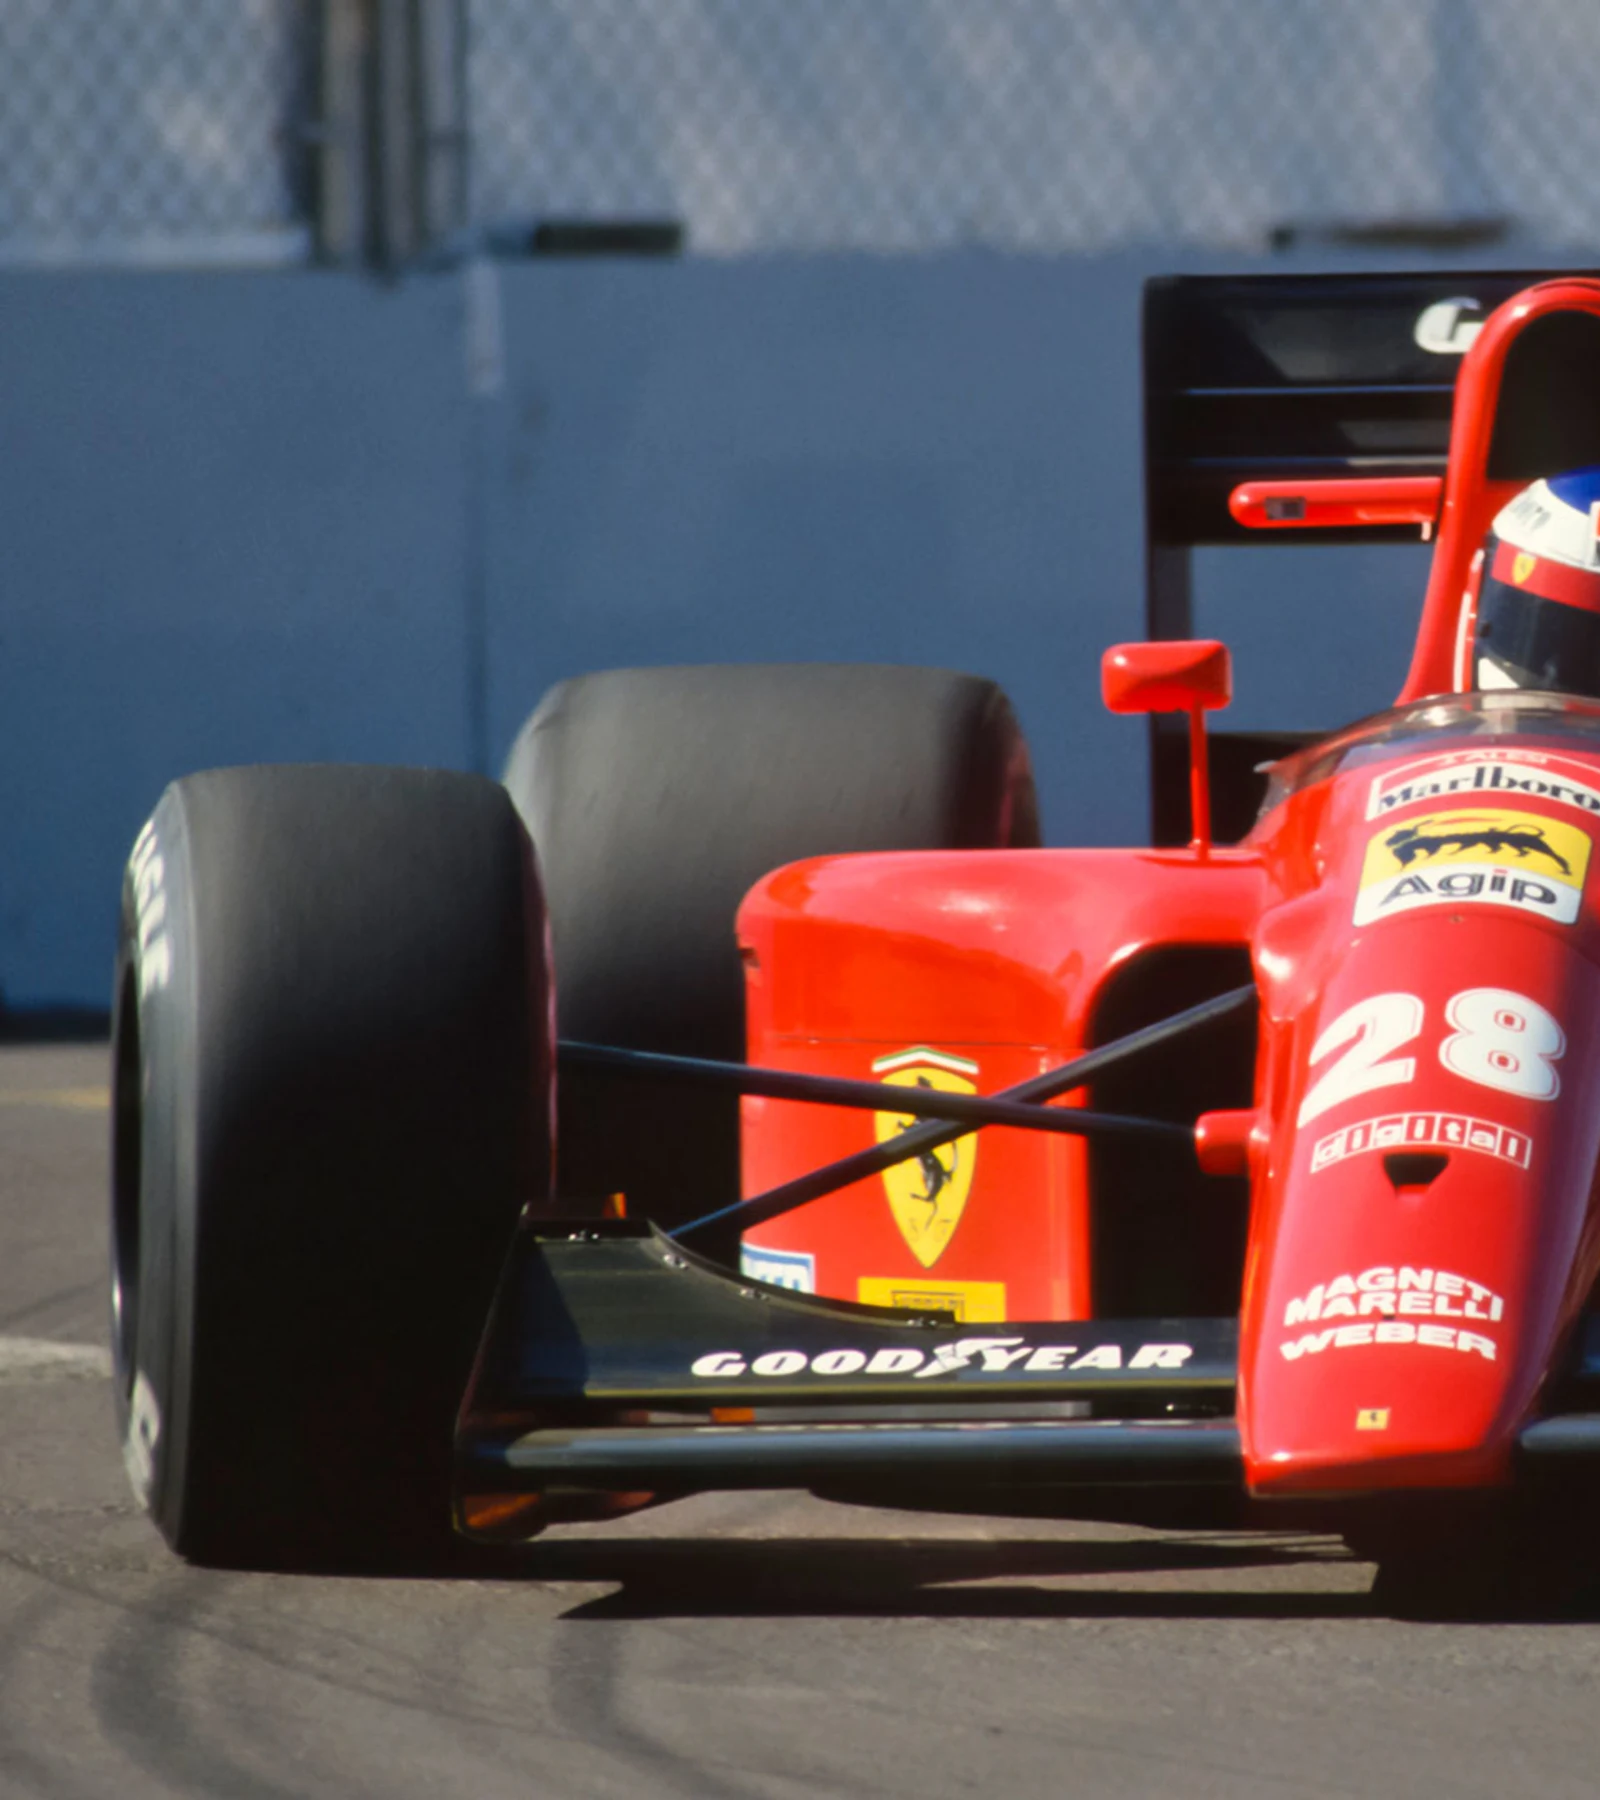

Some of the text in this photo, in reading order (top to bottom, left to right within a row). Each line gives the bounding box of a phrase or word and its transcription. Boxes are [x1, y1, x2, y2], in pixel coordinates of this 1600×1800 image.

[1378, 868, 1558, 907] Agip
[1297, 987, 1567, 1130] 28
[1312, 1114, 1526, 1168] digital
[1284, 1267, 1504, 1325] MAGNETI
[1284, 1291, 1504, 1326] MARELLI
[691, 1339, 1193, 1377] GOODYEAR
[1280, 1322, 1496, 1361] WEBER
